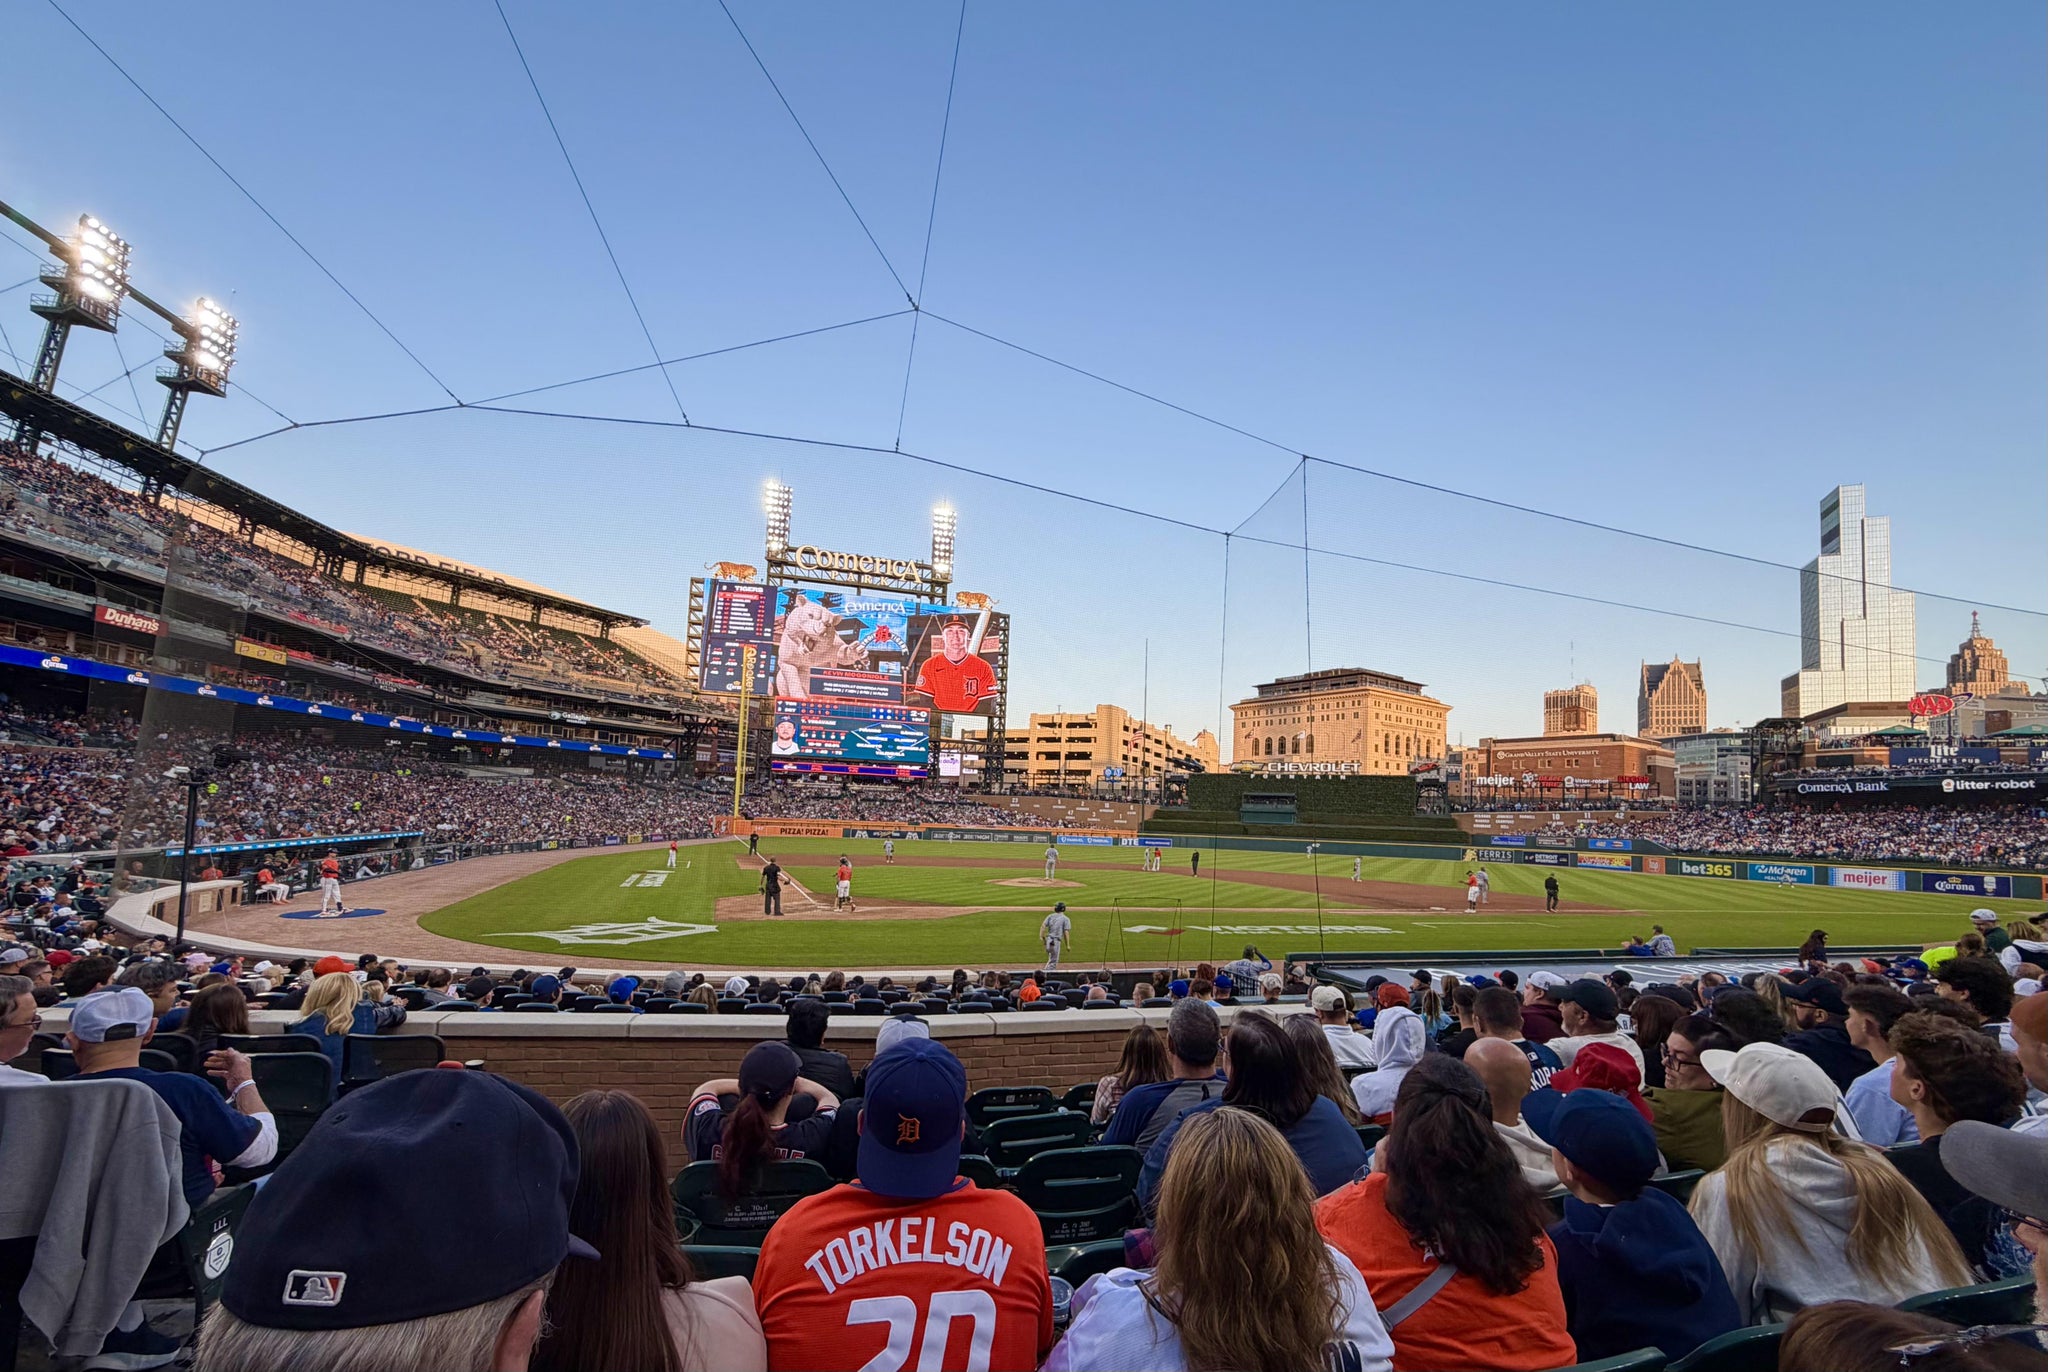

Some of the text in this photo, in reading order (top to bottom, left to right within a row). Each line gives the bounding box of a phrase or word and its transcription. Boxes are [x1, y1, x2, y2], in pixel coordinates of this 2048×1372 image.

[831, 571, 889, 586] PARK
[104, 608, 160, 631] Dunham's
[963, 675, 979, 699] D
[1912, 697, 1951, 715] AAA
[562, 711, 592, 721] Gallagher
[1930, 745, 1959, 758] Lite
[1267, 762, 1361, 773] CHEVROLET
[1476, 774, 1515, 787] meijer
[1856, 782, 1888, 792] Bank
[1956, 780, 2035, 790] litter-robot
[780, 828, 829, 836] PIZZA! PIZZA!
[1122, 838, 1138, 846] DTE
[1479, 850, 1512, 859] FERRIS
[1682, 862, 1732, 876] bet365
[1843, 871, 1888, 886] meijer
[1935, 880, 1975, 892] Corona
[897, 1112, 920, 1145] D
[804, 1216, 1013, 1294] TORKELSON
[846, 1289, 997, 1372] 20
